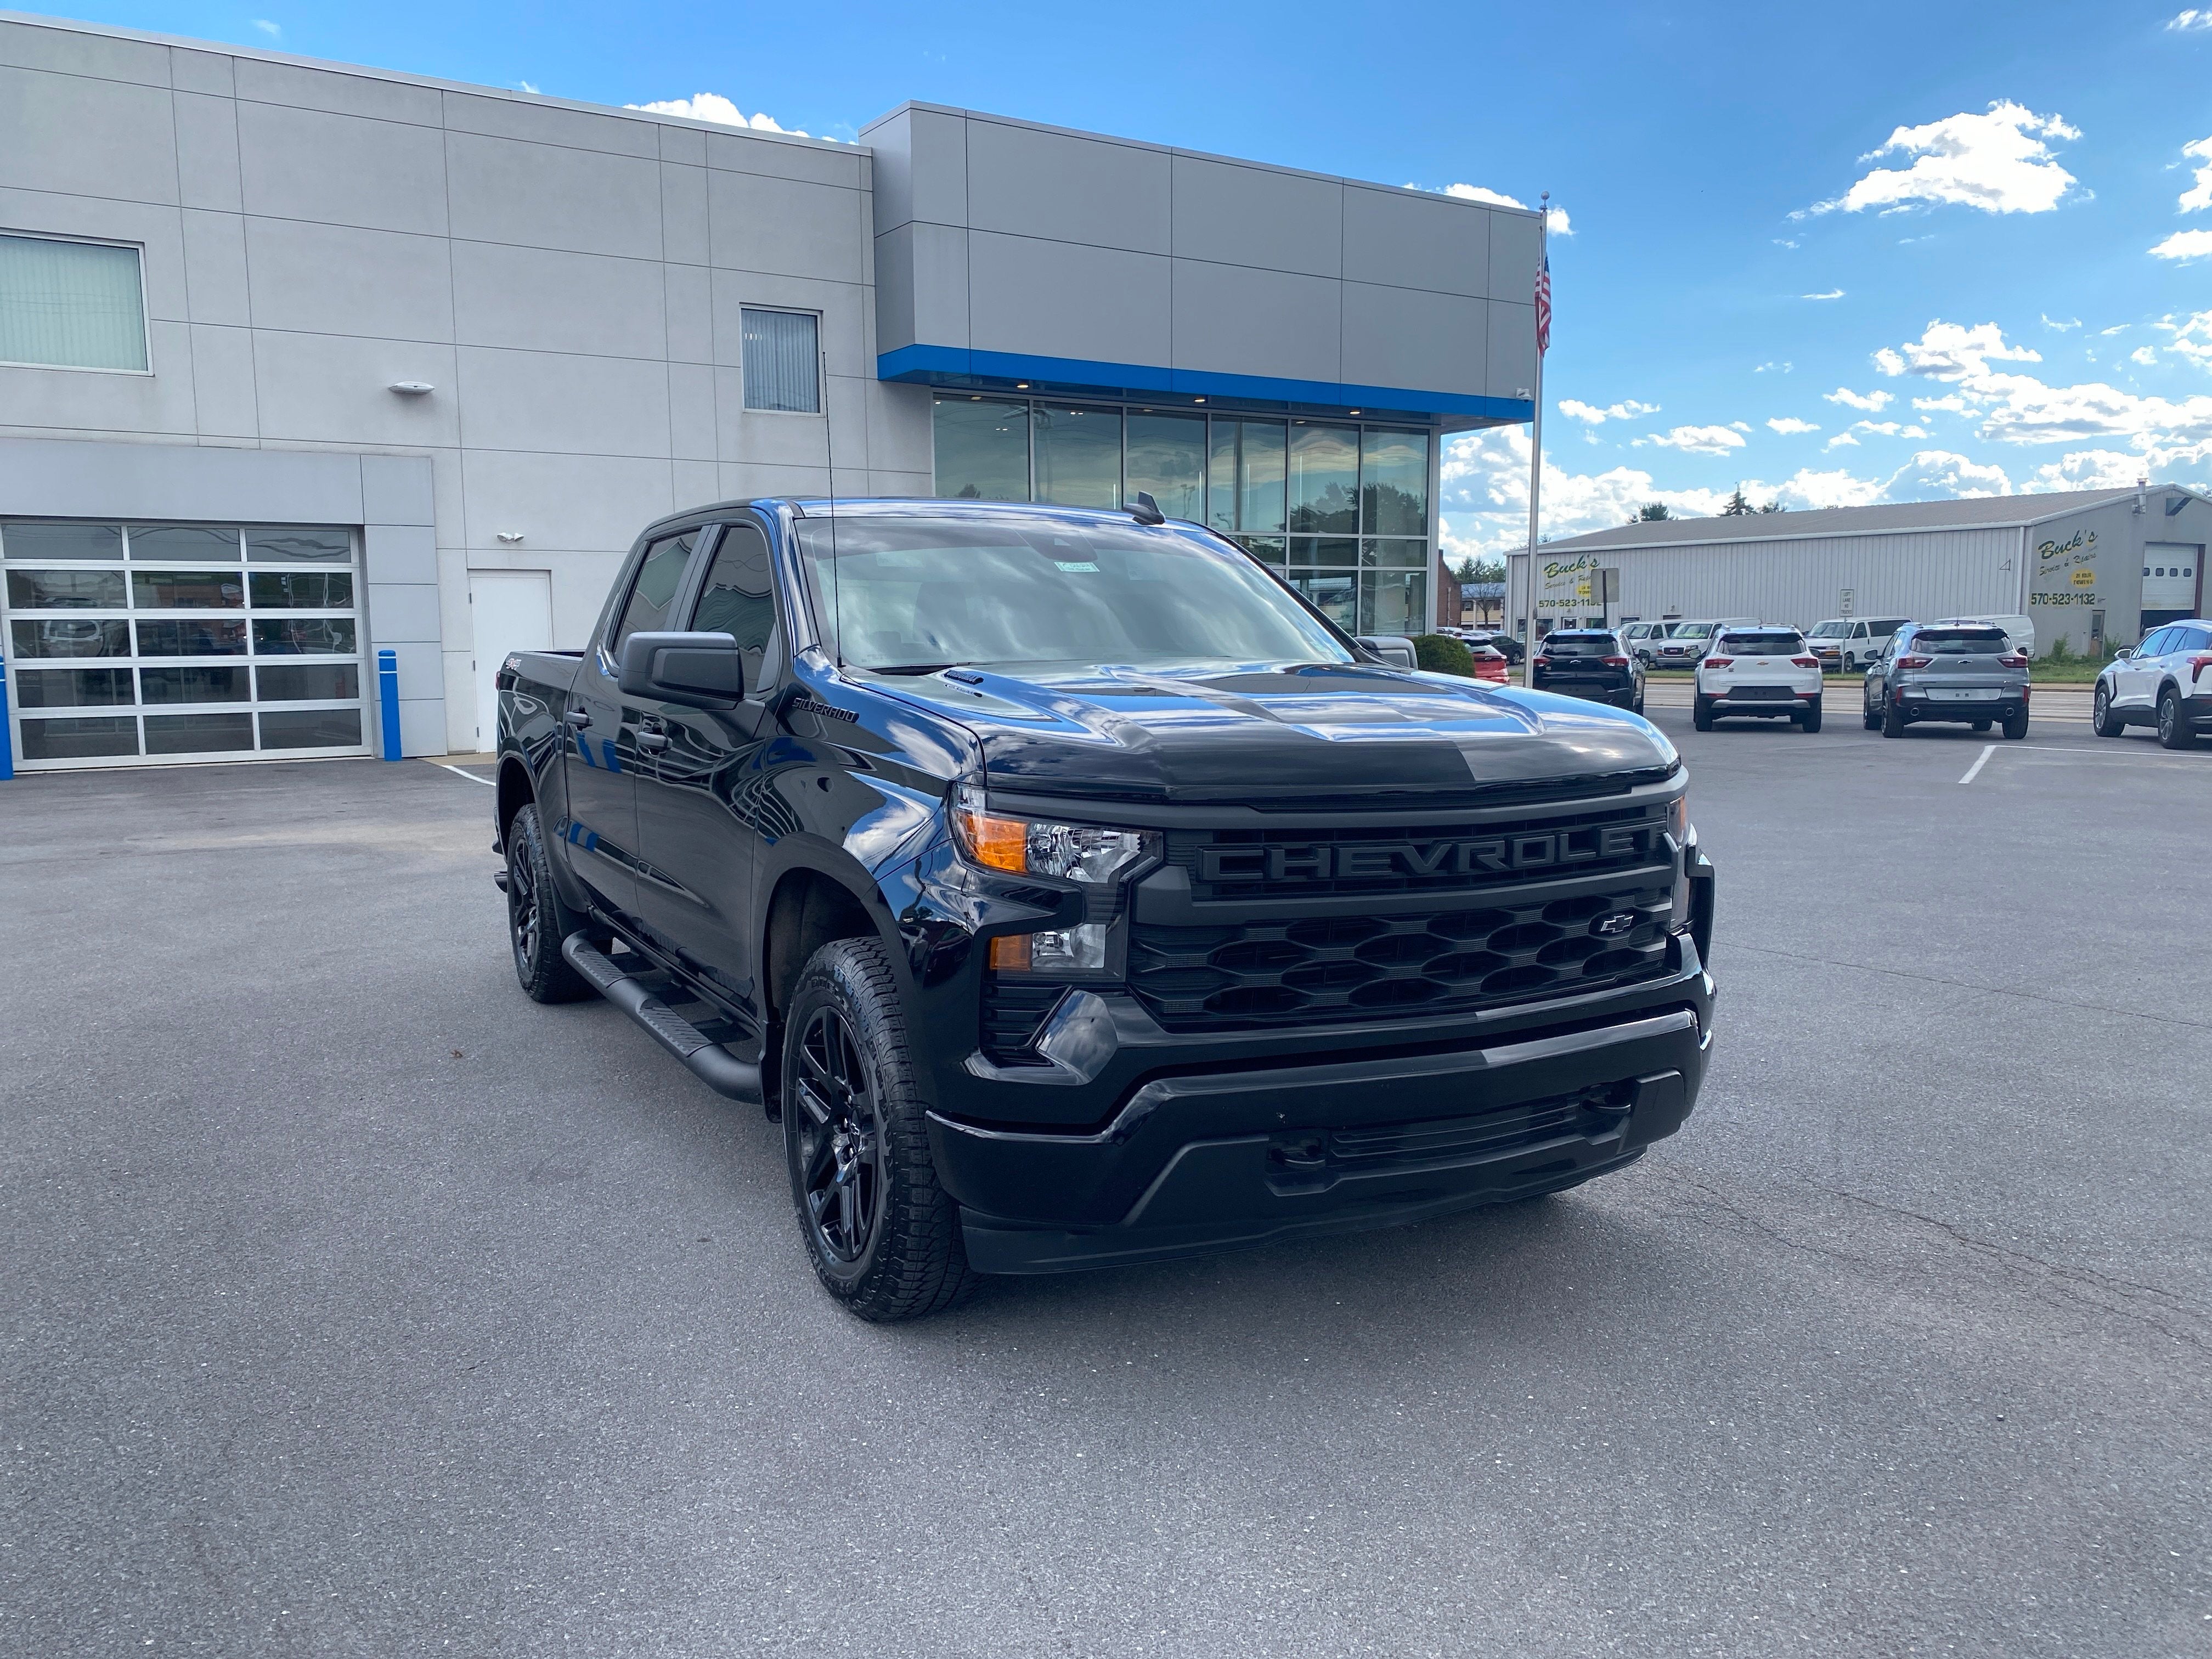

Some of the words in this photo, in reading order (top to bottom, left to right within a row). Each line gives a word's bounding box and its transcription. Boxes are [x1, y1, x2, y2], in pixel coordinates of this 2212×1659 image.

[2038, 529, 2098, 560] Buck's
[1543, 554, 1600, 578] Buck's
[2031, 593, 2095, 605] 570-523-1132
[792, 697, 858, 723] SILVERADO
[1195, 820, 1668, 882] CHEVROLET
